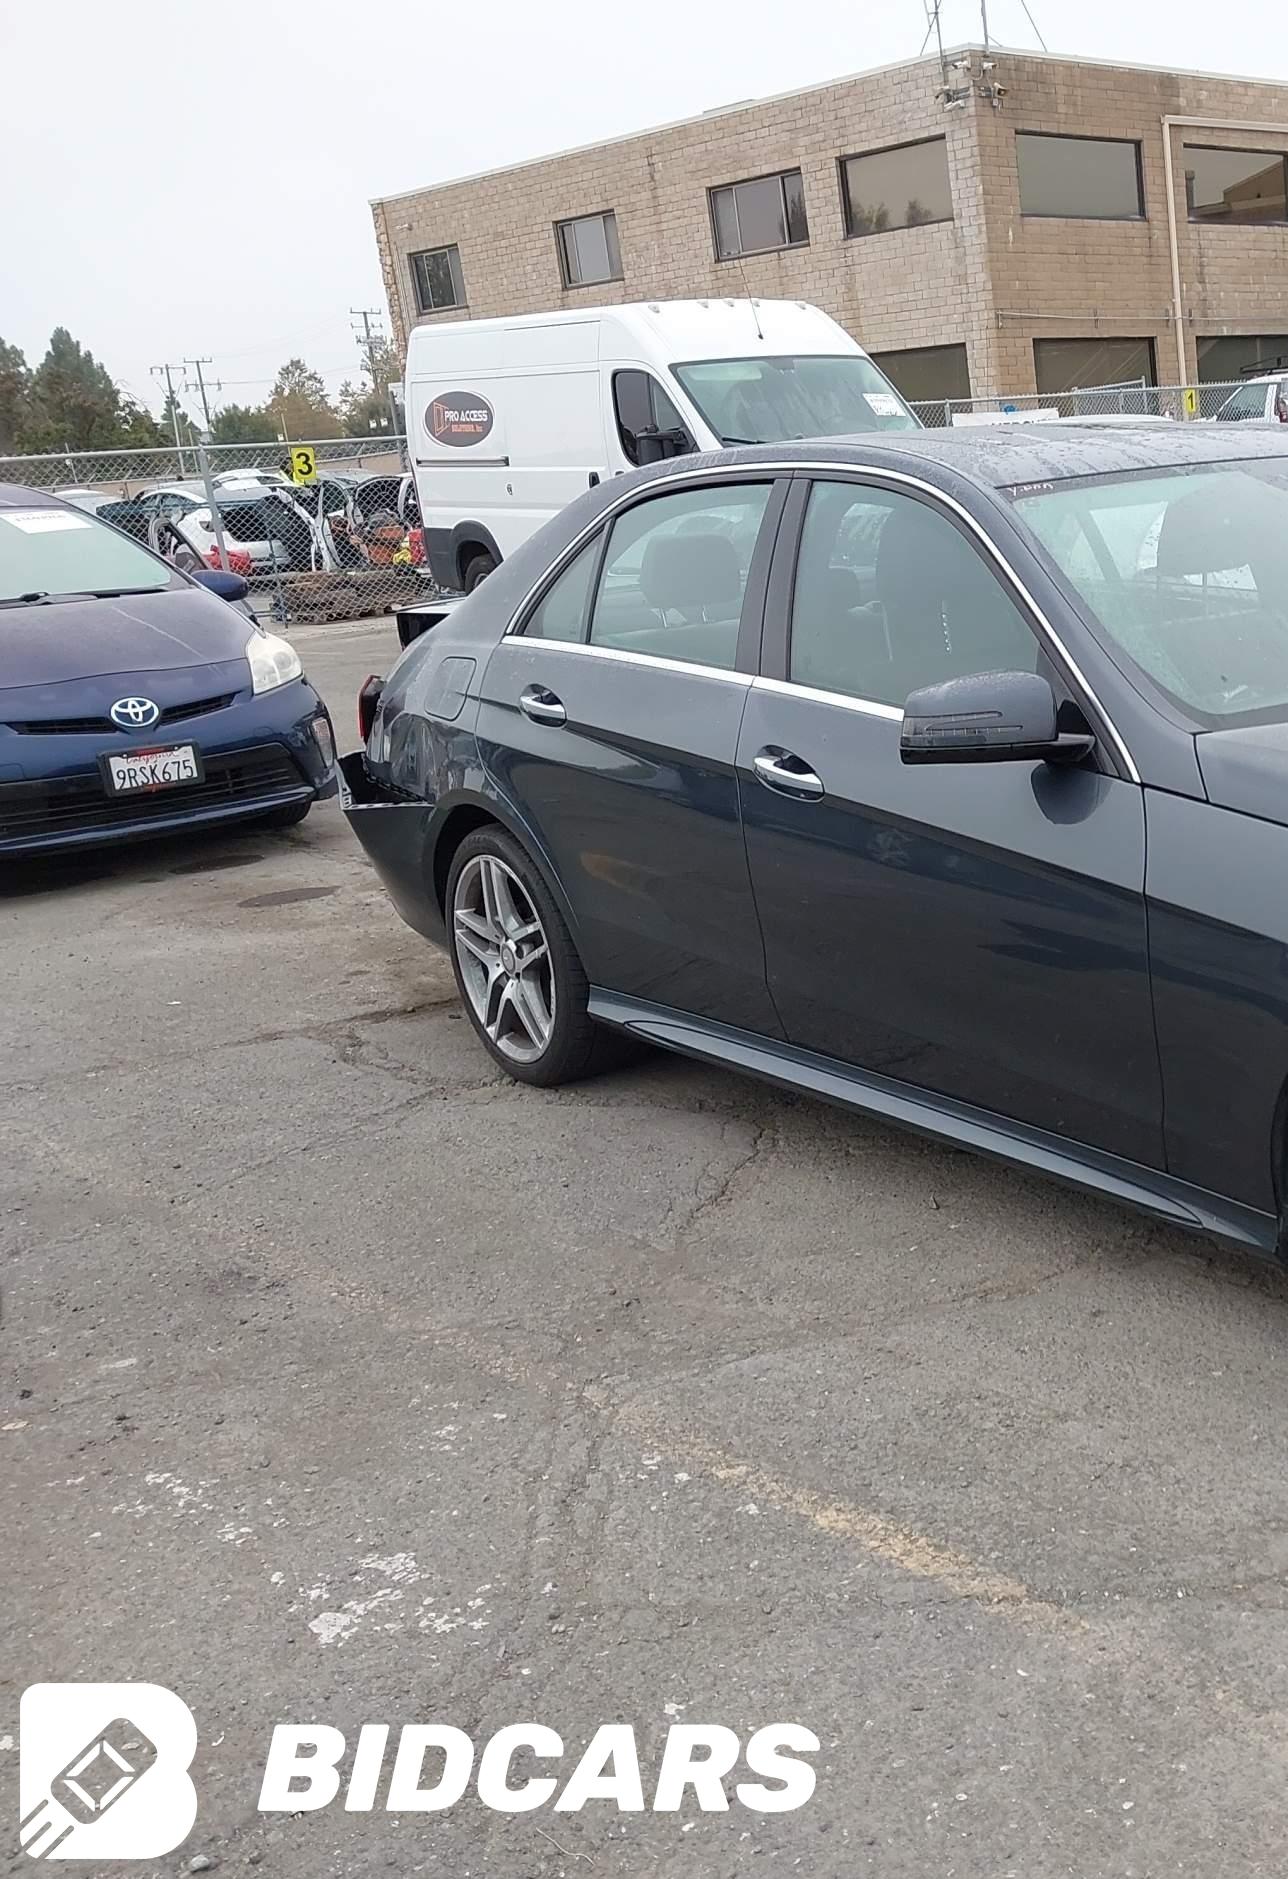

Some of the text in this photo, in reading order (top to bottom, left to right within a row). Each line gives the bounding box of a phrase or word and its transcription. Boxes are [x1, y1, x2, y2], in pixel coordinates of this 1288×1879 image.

[1187, 392, 1194, 409] 1
[444, 409, 488, 421] PRO ACCESS
[296, 452, 313, 475] 3
[116, 760, 194, 788] 9RSK675
